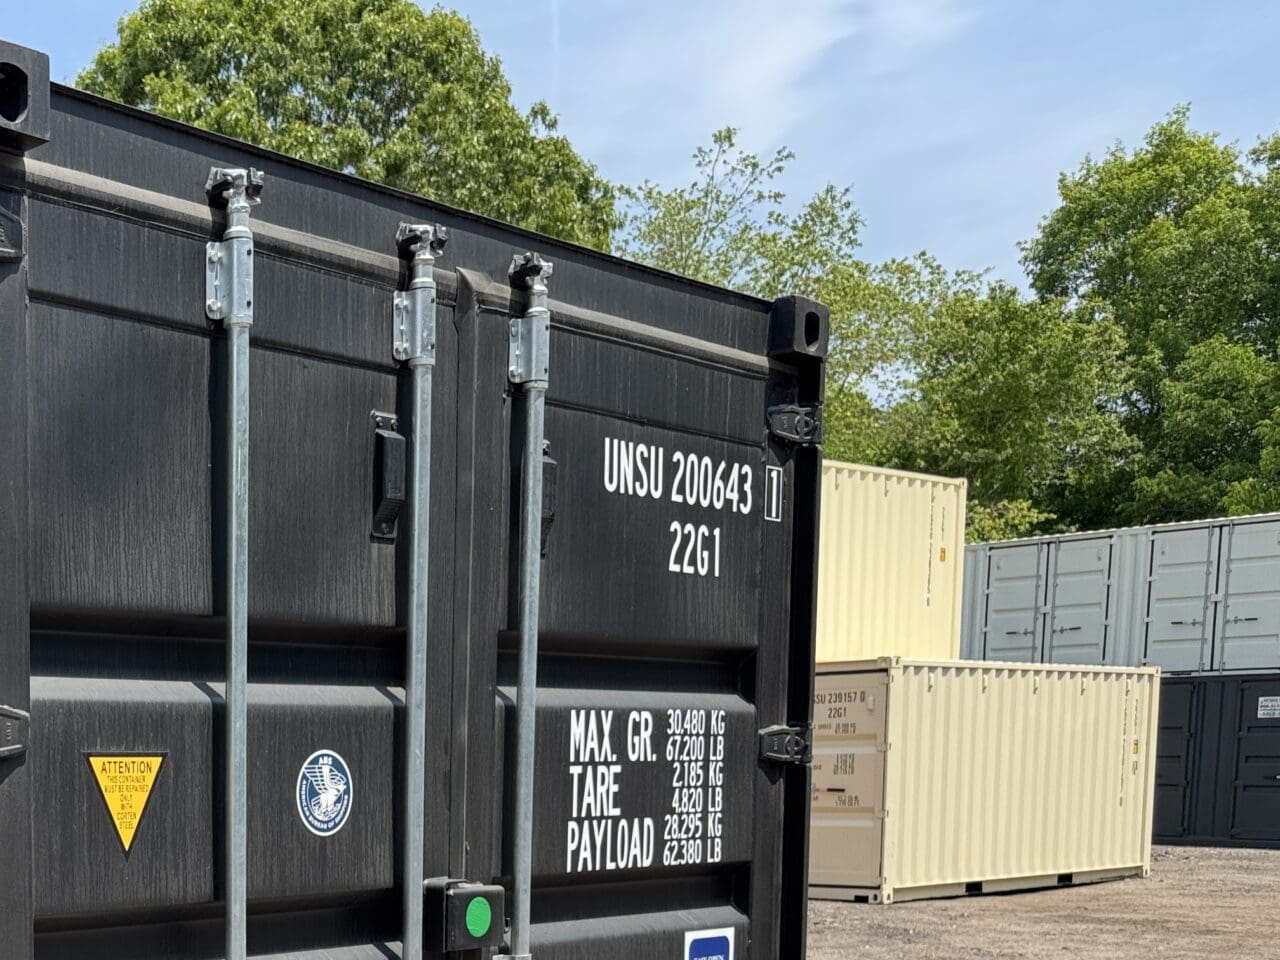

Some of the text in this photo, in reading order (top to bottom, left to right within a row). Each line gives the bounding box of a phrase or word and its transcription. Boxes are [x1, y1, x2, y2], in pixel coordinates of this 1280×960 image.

[604, 437, 664, 499] UNSU
[671, 450, 753, 515] 200643
[669, 520, 720, 577] 22G1
[828, 691, 857, 704] 239157
[828, 706, 847, 718] 22G1
[570, 709, 617, 763] MAX.
[627, 710, 657, 762] GR.
[710, 708, 725, 735] KG
[709, 735, 724, 761] LB
[101, 761, 152, 774] ATTENTION
[570, 765, 622, 818] TARE
[709, 761, 724, 787] KG
[708, 787, 723, 812] LB
[566, 817, 655, 873] PAYLOAD
[707, 812, 723, 838] KG
[707, 838, 722, 864] LB
